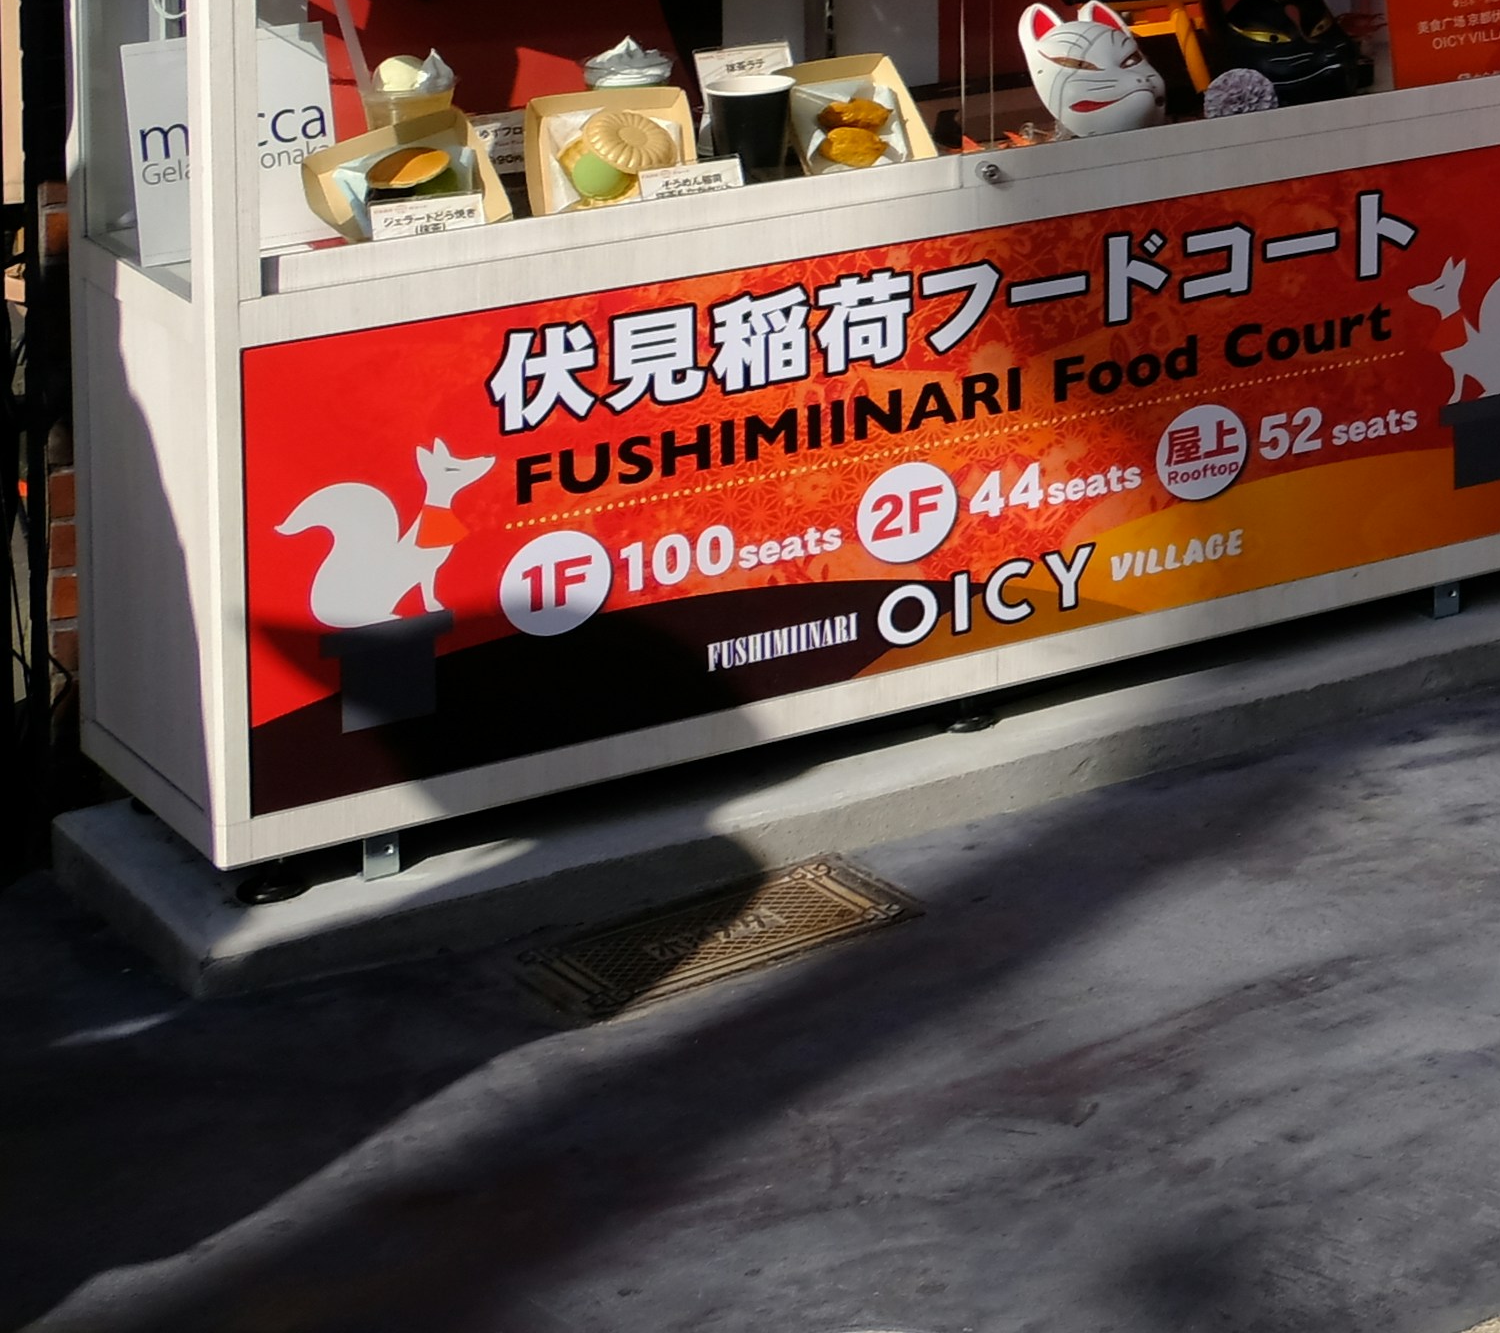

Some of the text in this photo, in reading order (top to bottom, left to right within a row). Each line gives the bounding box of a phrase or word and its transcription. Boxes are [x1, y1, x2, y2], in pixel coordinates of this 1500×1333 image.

[1431, 32, 1466, 50] OICY
[490, 189, 1418, 433] 伏見稲荷フードコート
[516, 302, 1393, 504] FUSHIMIINARI Food Court
[1164, 419, 1240, 468] 屋上
[1166, 459, 1240, 487] Rooftop
[870, 485, 944, 543] 2F
[520, 554, 593, 614] 1F
[706, 529, 1244, 673] FUSHIMIINARI OICY VILLAGE
